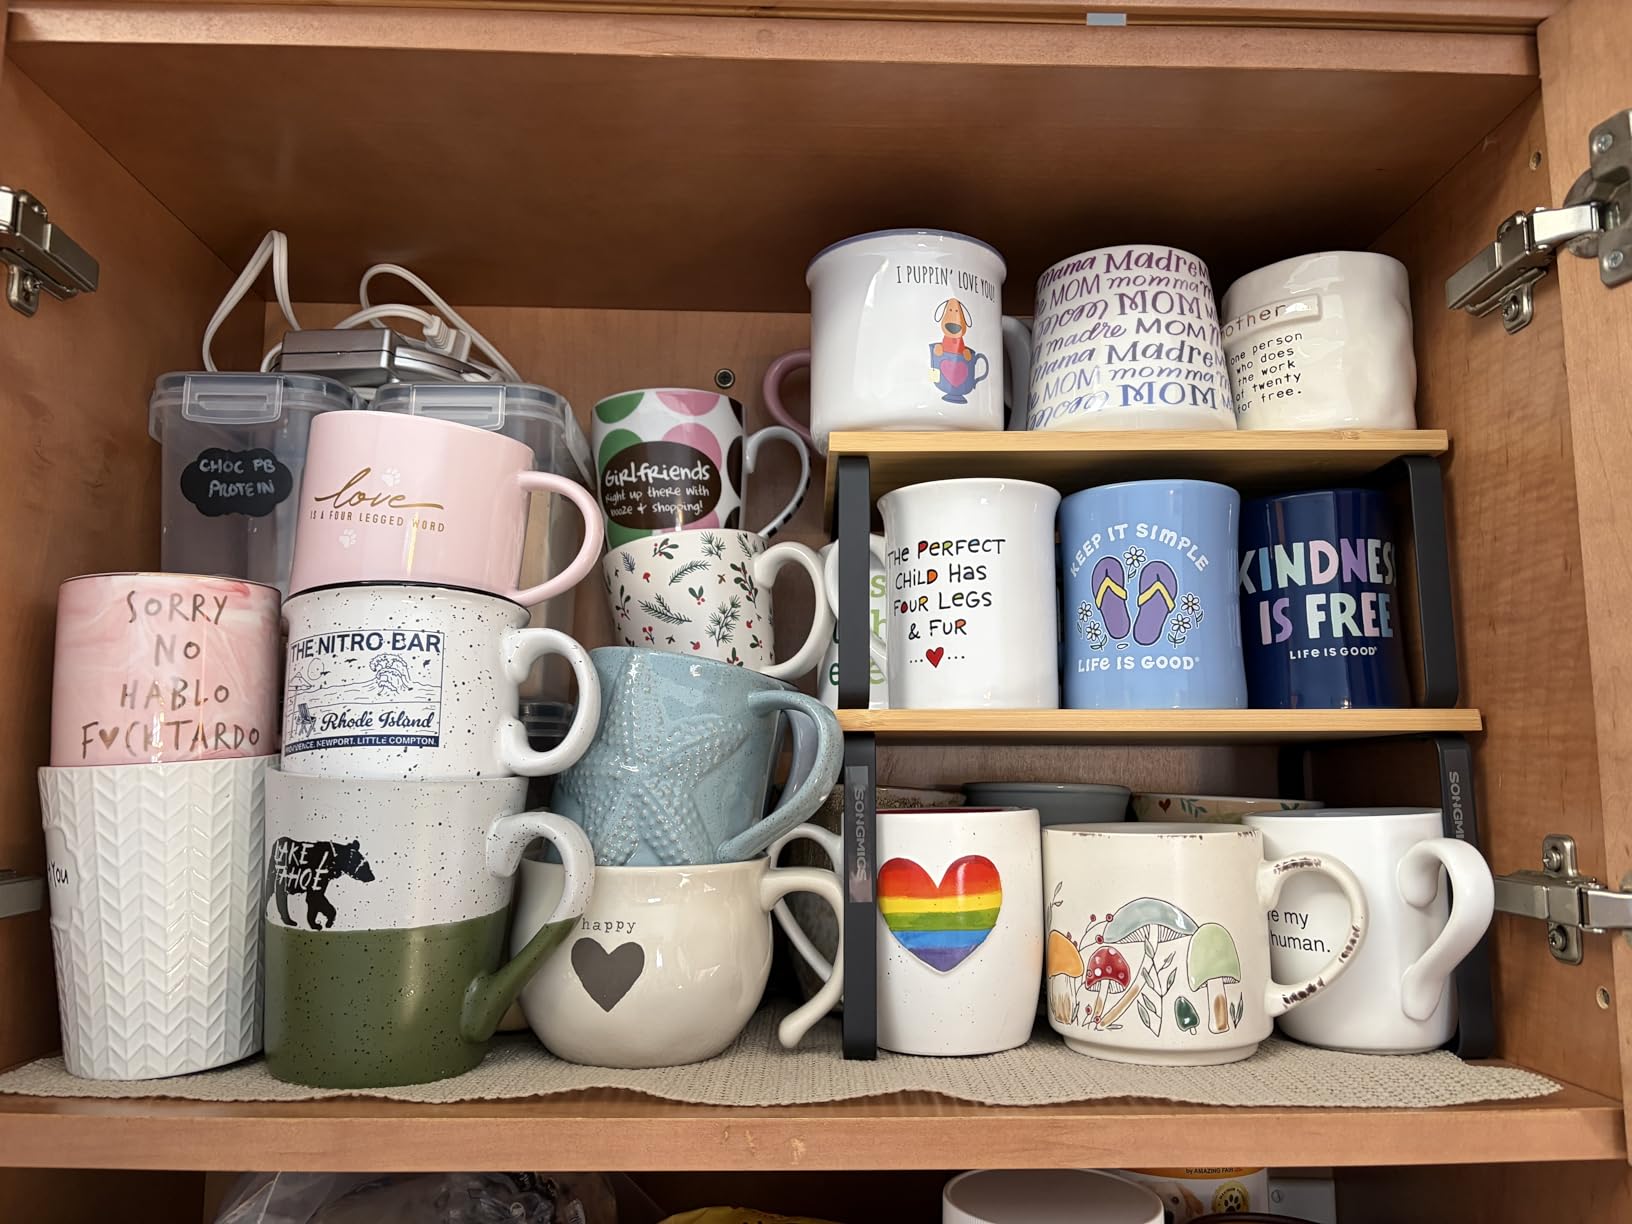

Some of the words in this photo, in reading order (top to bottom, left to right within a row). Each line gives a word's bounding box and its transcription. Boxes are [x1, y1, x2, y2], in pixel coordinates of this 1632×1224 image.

[1104, 250, 1197, 278] Madre
[896, 265, 902, 284] I
[958, 270, 979, 294] LOVE
[1051, 273, 1101, 309] MOM
[1107, 275, 1199, 293] momma
[1115, 290, 1203, 320] MOM
[1046, 322, 1128, 357] madre
[1135, 317, 1207, 342] MOM
[1230, 351, 1246, 366] one
[1252, 332, 1303, 356] person
[1104, 339, 1213, 368] Madre
[1236, 361, 1254, 374] who
[1260, 347, 1295, 363] does
[1044, 364, 1101, 399] MOM
[1109, 366, 1214, 384] momma
[1235, 389, 1244, 402] of
[1252, 373, 1302, 393] twenty
[1238, 373, 1254, 387] the
[1261, 359, 1296, 376] work
[1117, 381, 1217, 410] MOM
[1237, 400, 1253, 414] for
[1261, 388, 1302, 403] free.
[199, 459, 244, 474] CHOC
[252, 459, 276, 473] PB
[208, 480, 275, 498] PROTEIN
[314, 467, 444, 510] love
[629, 490, 643, 502] up
[310, 510, 317, 520] IS
[329, 511, 353, 521] FOUR
[359, 512, 404, 527] LEGGED
[412, 518, 445, 533] WORD
[652, 500, 704, 516] shopping!
[1070, 533, 1101, 578] KEEP
[1107, 523, 1129, 542] IT
[1239, 538, 1397, 594] KINDNES
[126, 590, 228, 625] SORRY
[893, 595, 929, 617] FOUR
[1259, 597, 1293, 646] IS
[1305, 591, 1394, 640] FREE
[908, 622, 921, 640] &
[929, 618, 967, 637] FUR
[154, 634, 201, 667] NO
[291, 639, 314, 663] THE
[317, 632, 384, 656] NITRO
[391, 631, 441, 653] BAR
[1324, 647, 1337, 657] IS
[1116, 656, 1135, 670] IS
[120, 676, 230, 712] HABLO
[320, 711, 374, 732] Rhode
[378, 710, 436, 729] Island
[357, 736, 387, 745] LITTLE
[388, 736, 437, 746] COMPTON.
[1449, 771, 1465, 839] SONGMI
[274, 838, 315, 867] LAKE
[275, 851, 330, 891] TAHOE
[581, 917, 637, 935] happy
[1284, 911, 1309, 930] my
[1270, 929, 1331, 953] human.
